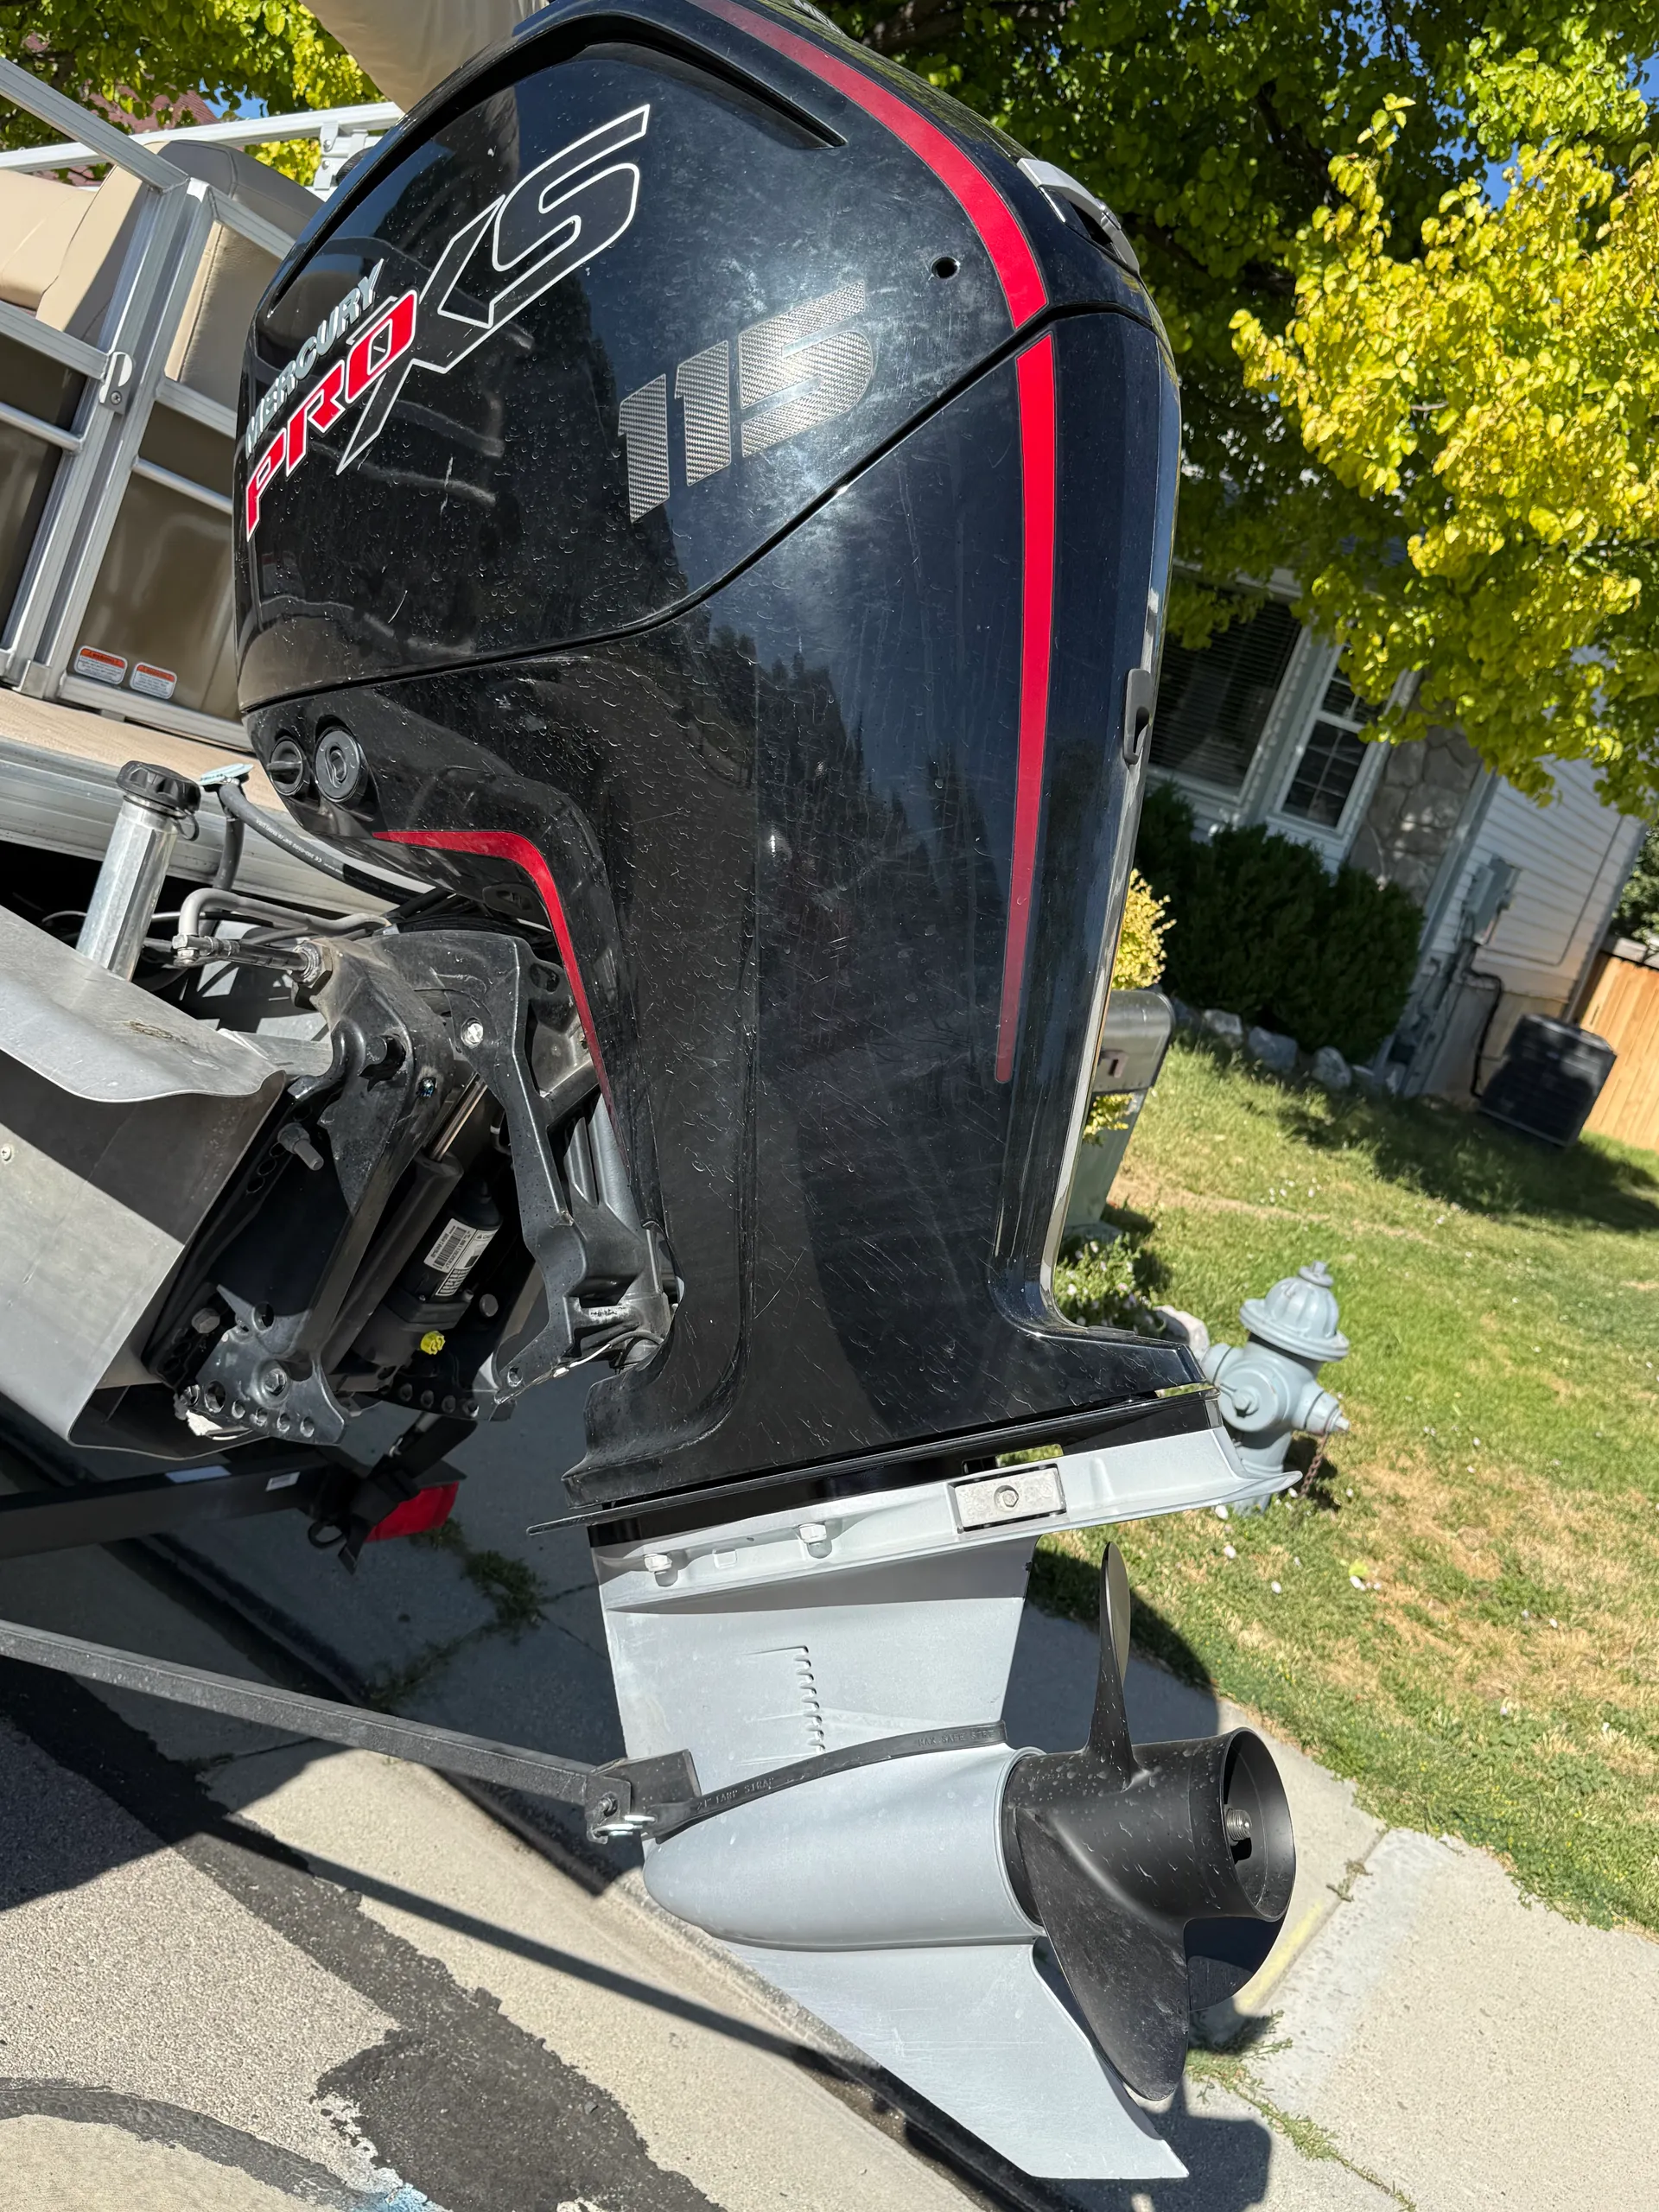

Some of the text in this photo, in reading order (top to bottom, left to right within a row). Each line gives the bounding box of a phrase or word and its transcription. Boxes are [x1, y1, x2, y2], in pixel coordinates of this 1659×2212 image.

[245, 104, 651, 543] PRO XS
[245, 258, 384, 459] MERCURY
[618, 281, 874, 524] 115
[744, 1777, 774, 1794] STRAP
[941, 1732, 966, 1744] SAFE
